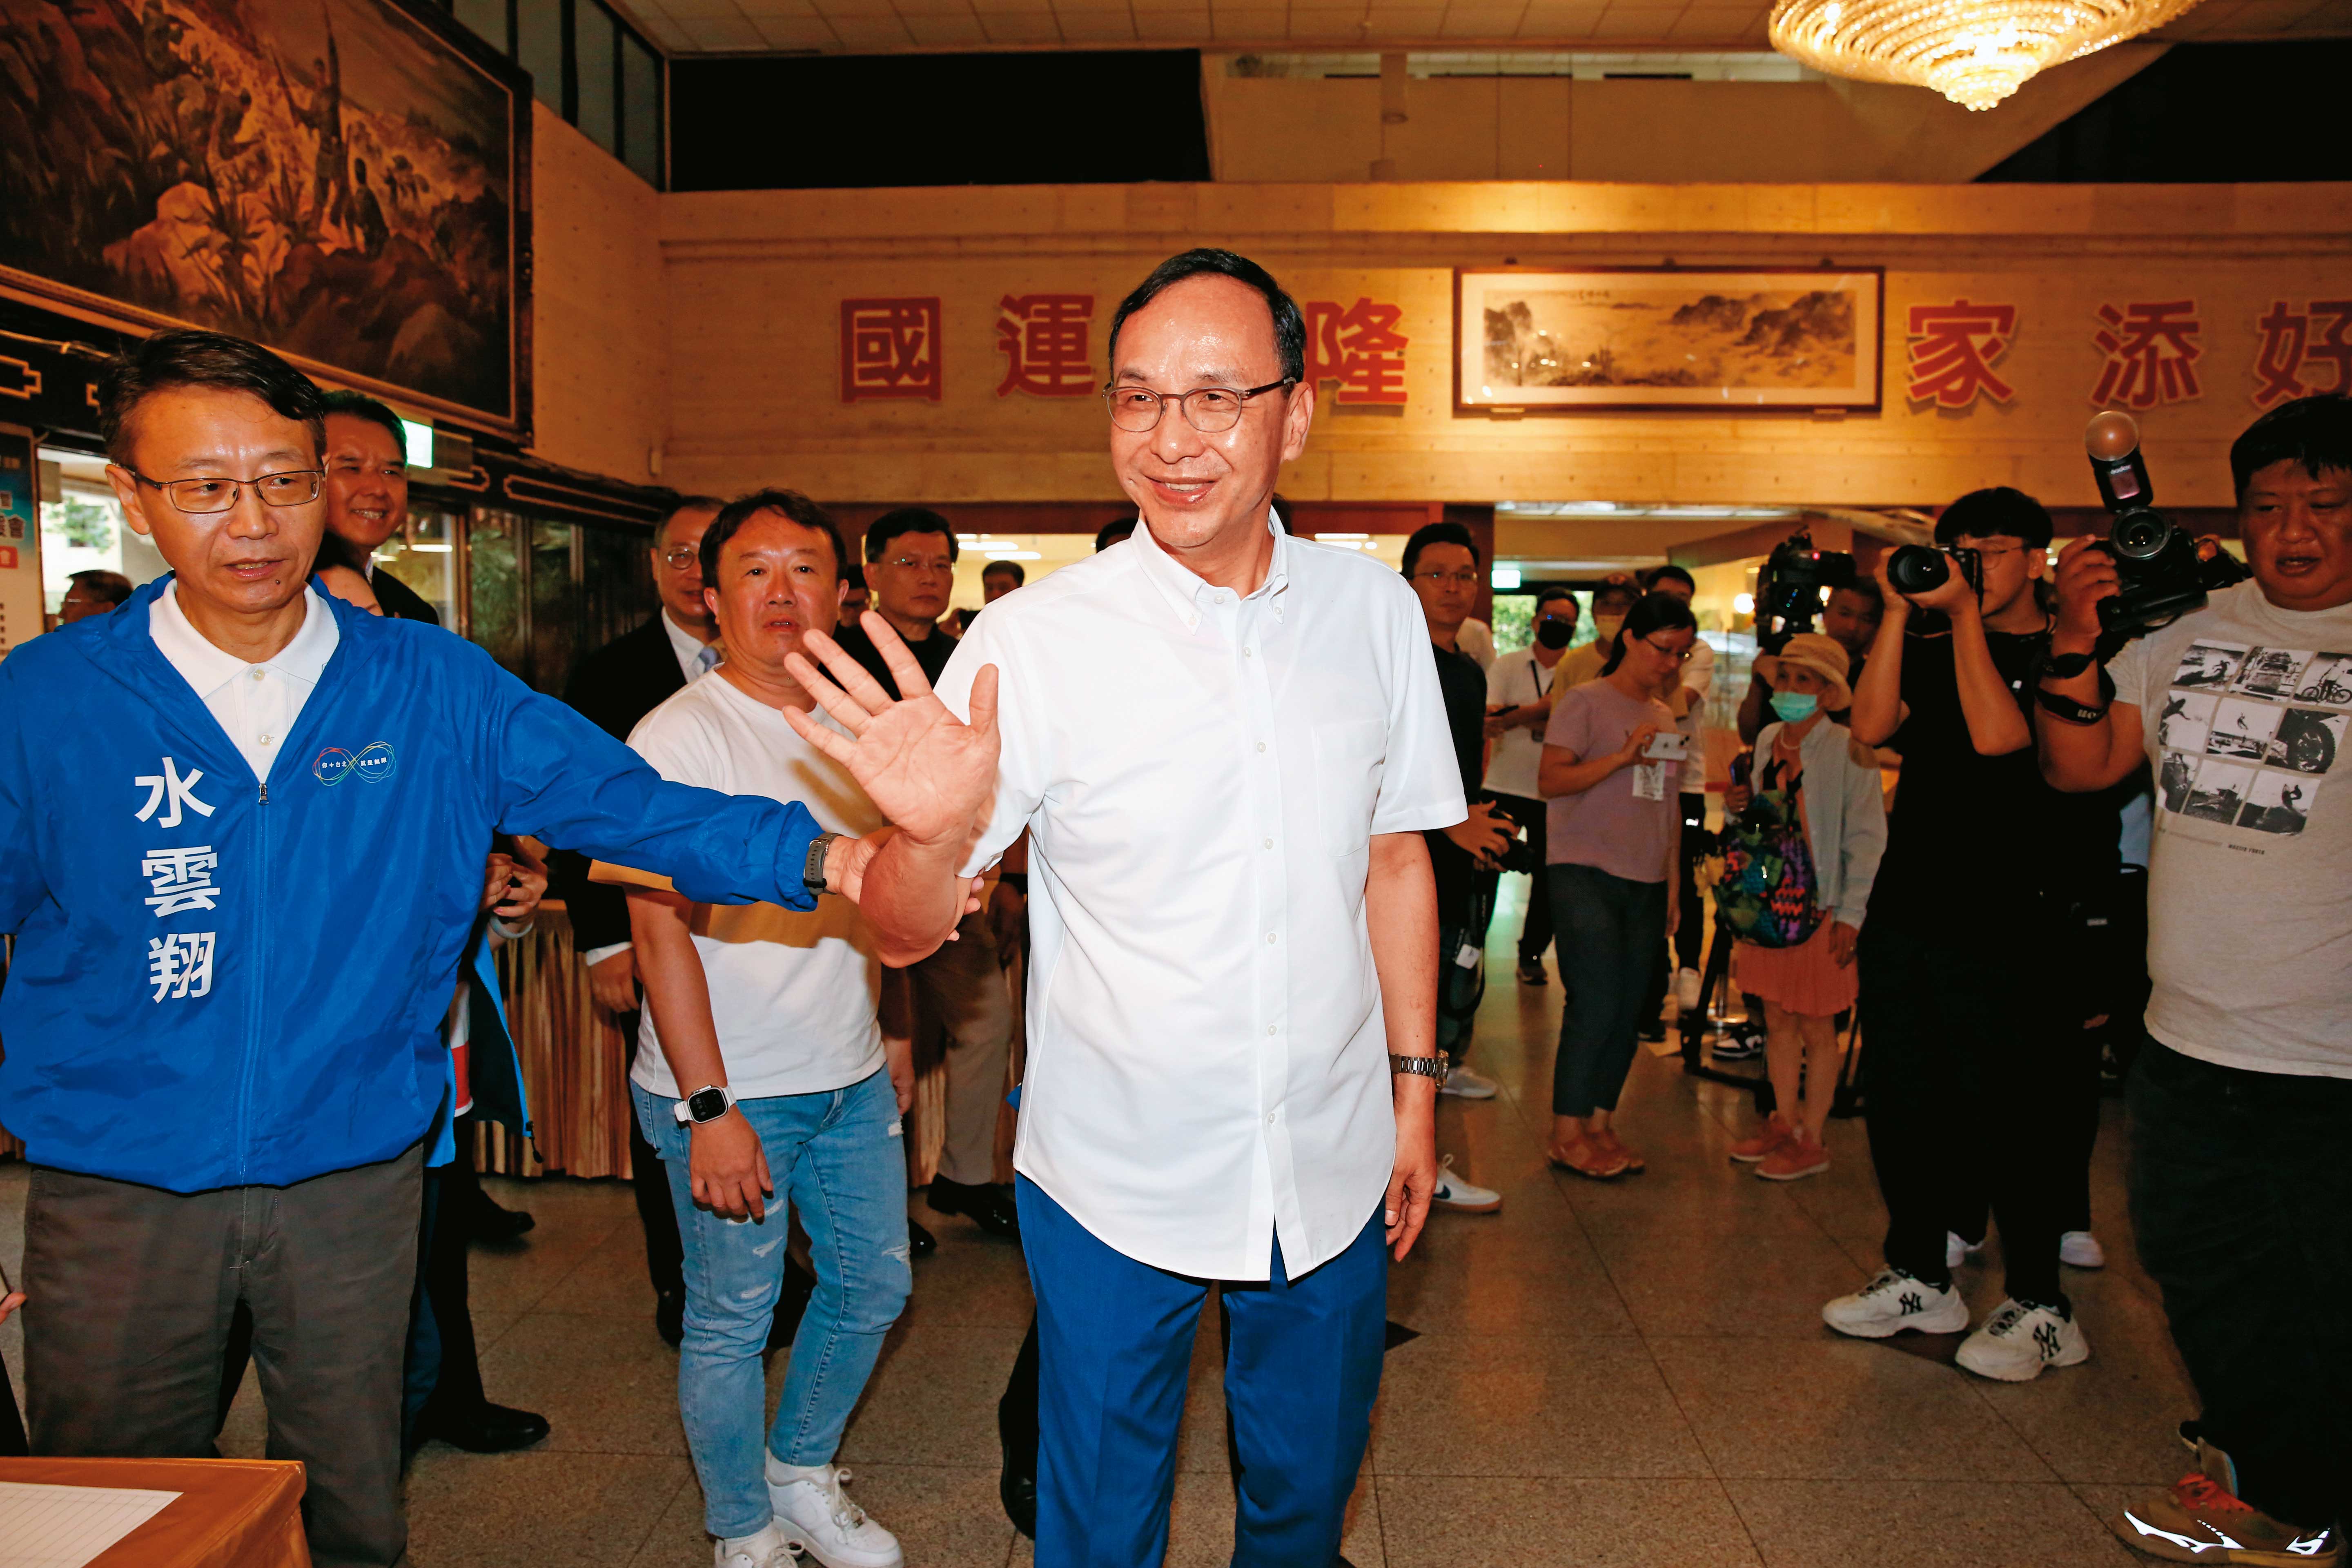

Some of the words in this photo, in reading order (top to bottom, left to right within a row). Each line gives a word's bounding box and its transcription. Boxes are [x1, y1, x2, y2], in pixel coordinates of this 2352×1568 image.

[841, 293, 1408, 404] 國運隆
[361, 757, 387, 766] 就是無限
[134, 757, 220, 1004] 水雲翔
